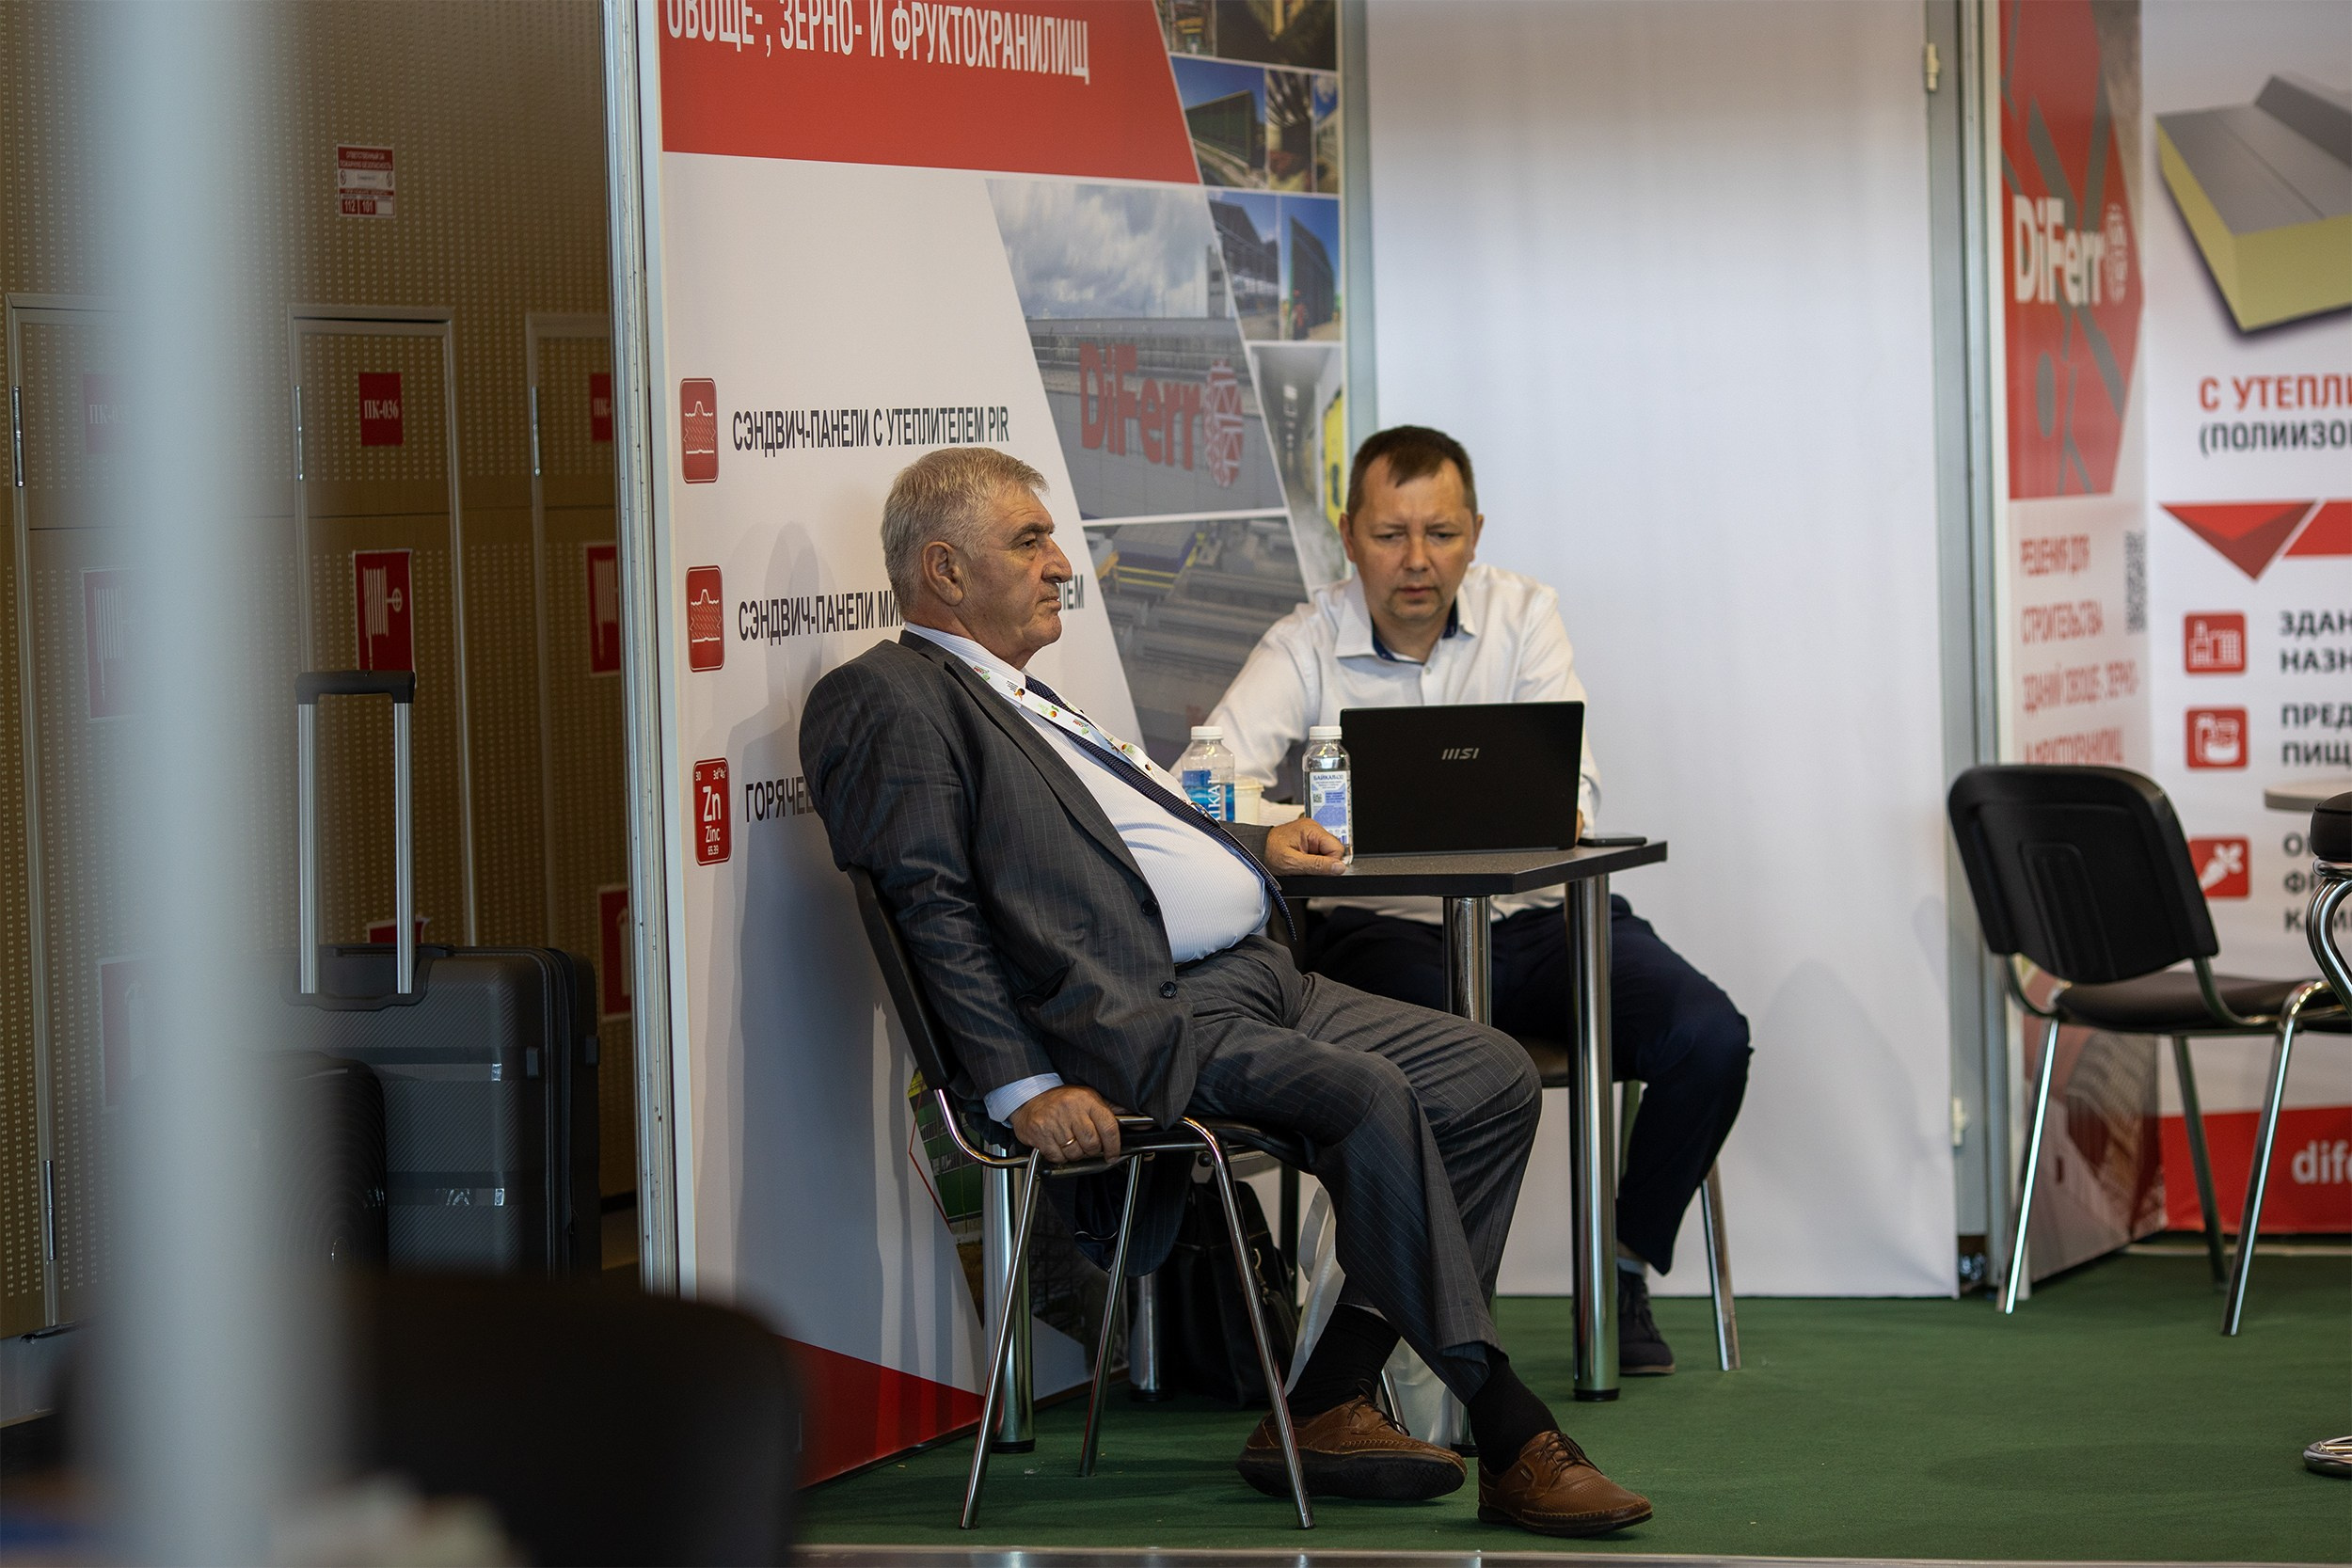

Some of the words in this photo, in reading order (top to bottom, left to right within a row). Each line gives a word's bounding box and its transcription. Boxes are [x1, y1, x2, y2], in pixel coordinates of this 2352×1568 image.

[780, 0, 863, 55] ЗЕРНО-
[869, 0, 885, 57] И
[891, 0, 1089, 86] ФРУКТОХРАНИЛИЩ
[2012, 194, 2105, 308] DiFerr
[364, 400, 399, 420] ПК-036
[1079, 341, 1201, 471] DiFerr
[2199, 376, 2220, 412] С
[2231, 372, 2352, 412] УТЕПЛ
[732, 407, 869, 457] СЭНДВИЧ-ПАНЕЛИ
[873, 408, 883, 447] С
[886, 406, 984, 446] УТЕПЛИТЕЛЕМ
[988, 406, 1010, 442] PIR
[2200, 419, 2352, 457] (ПОЛИИЗО
[739, 591, 875, 646] СЭНДВИЧ-ПАНЕЛИ
[702, 785, 722, 823] Zn
[706, 825, 721, 843] Zinc
[2291, 1139, 2352, 1185] dif
